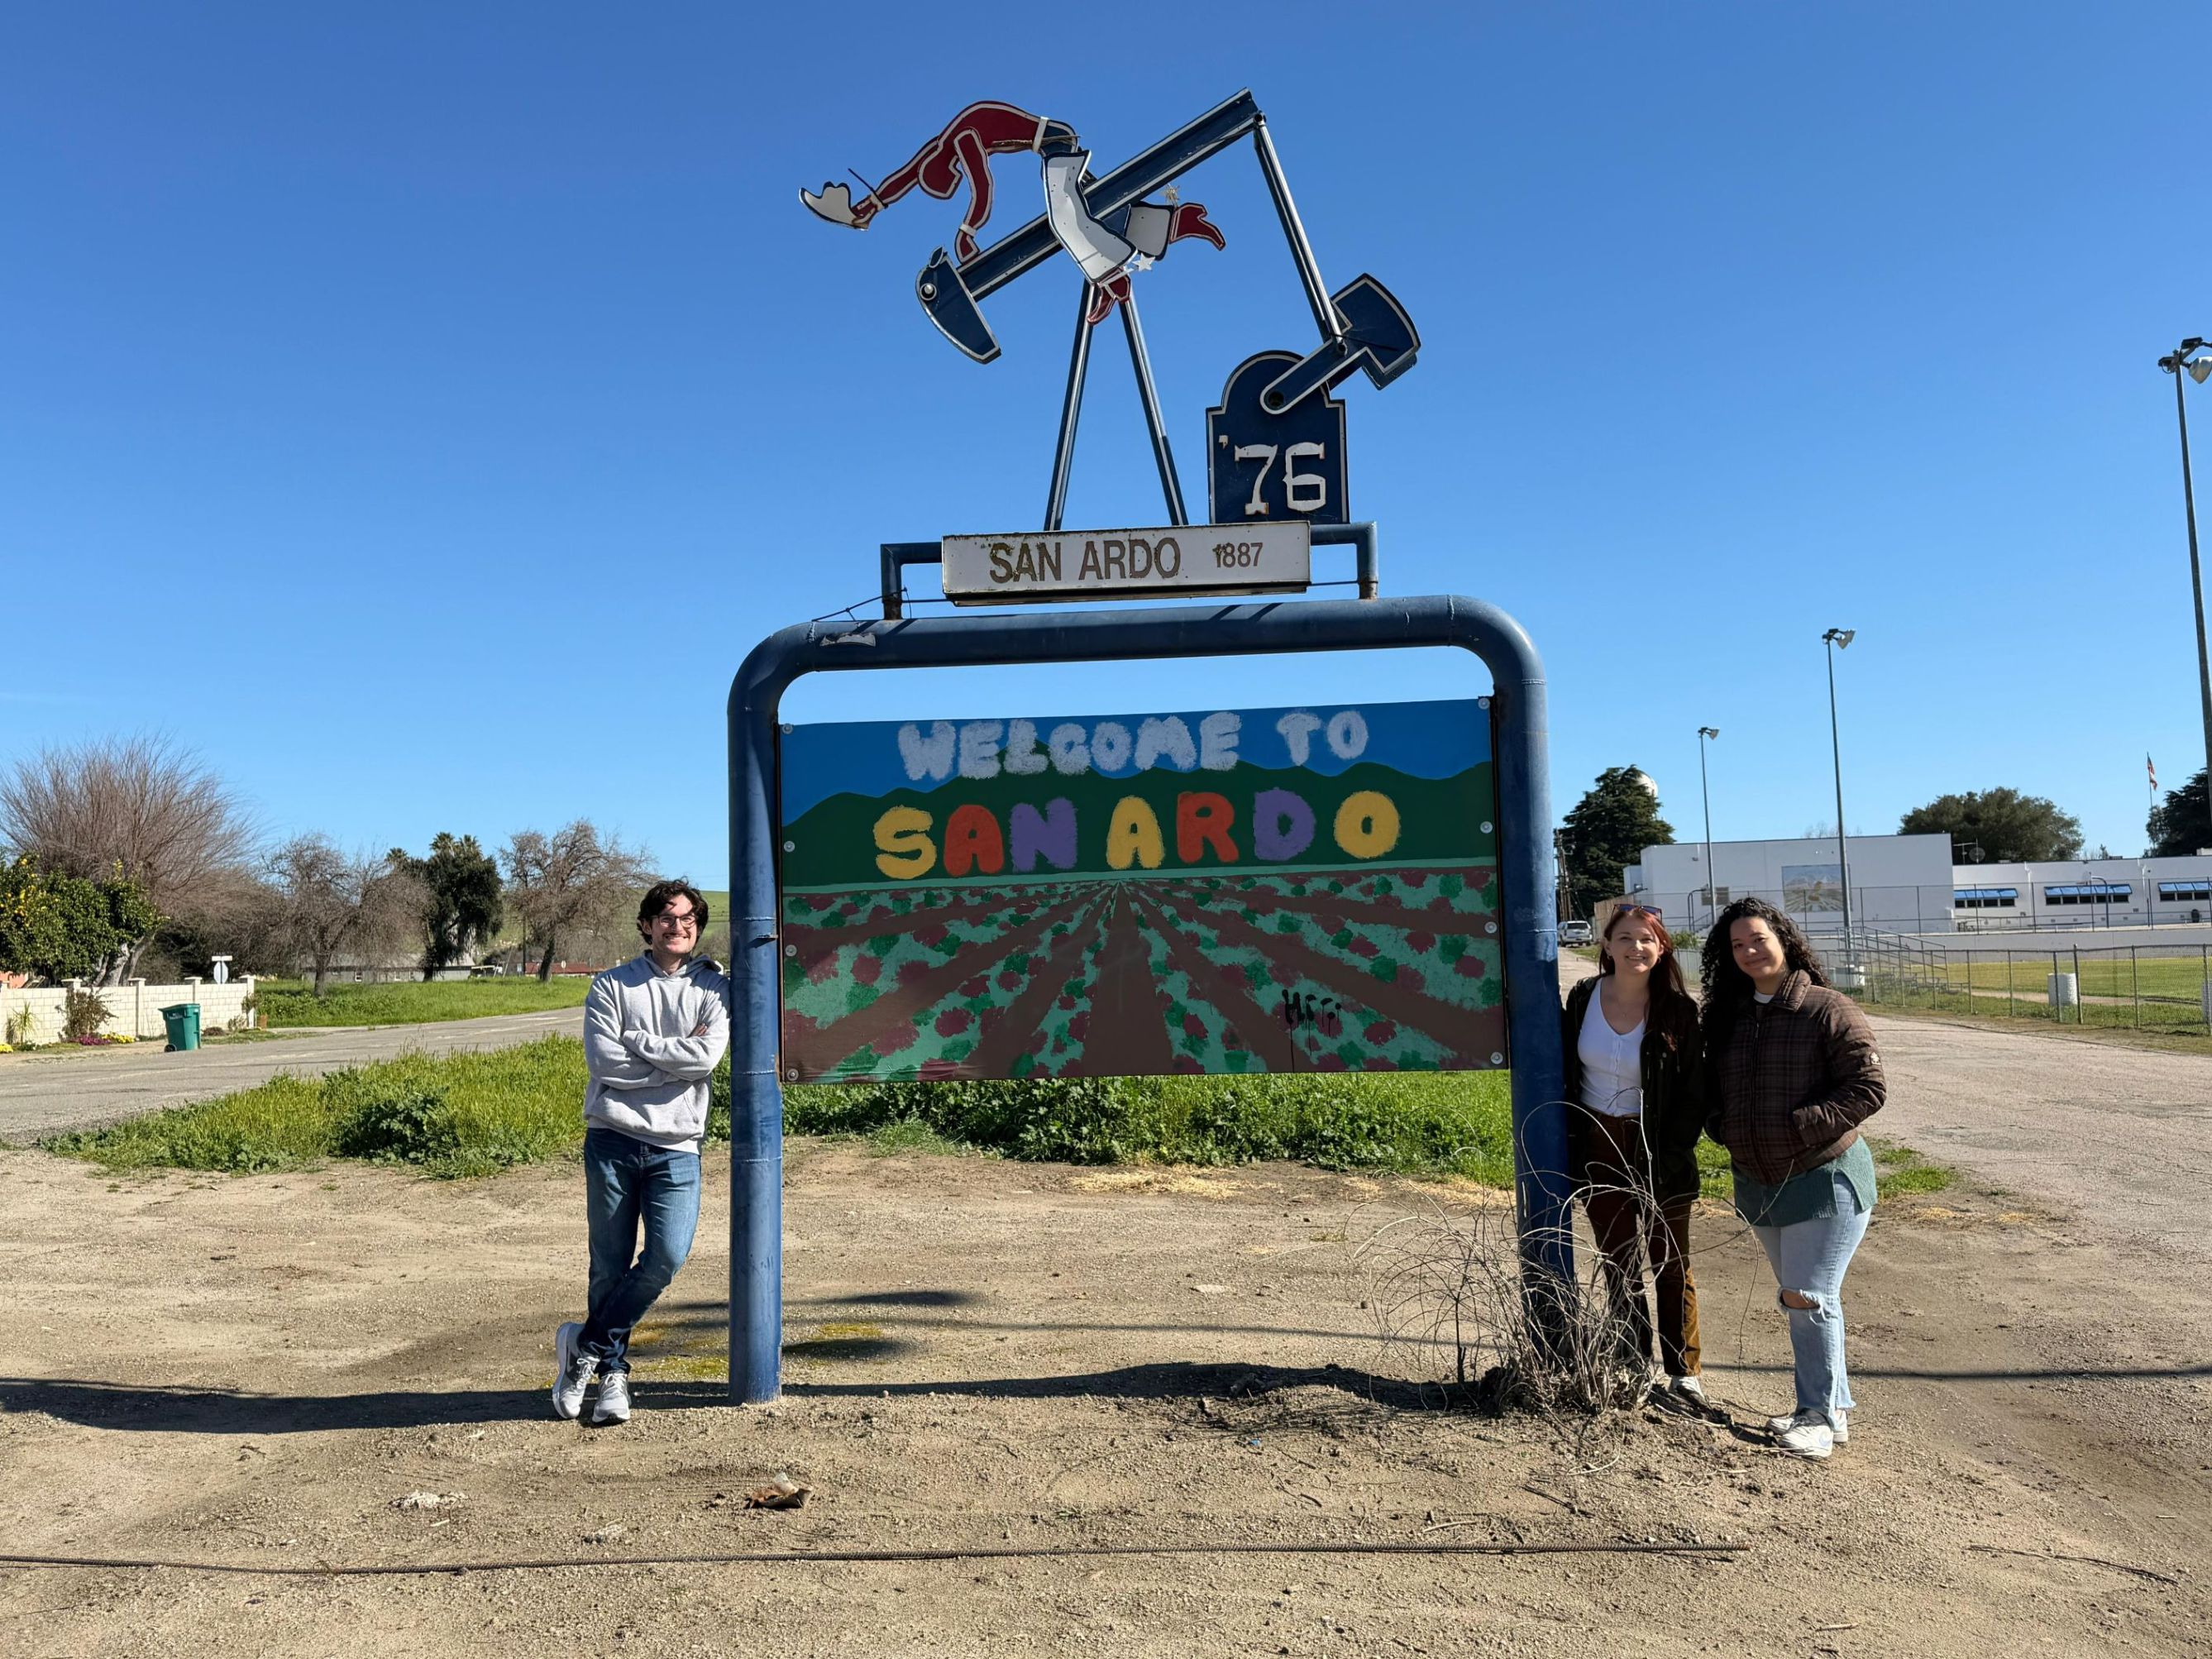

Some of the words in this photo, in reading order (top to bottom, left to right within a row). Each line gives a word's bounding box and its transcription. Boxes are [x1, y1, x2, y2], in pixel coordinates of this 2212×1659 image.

[989, 542, 1063, 584] SAN
[1078, 538, 1182, 582] ARDO
[1214, 542, 1264, 569] 1887
[897, 712, 1244, 781] WELCOME
[1277, 710, 1369, 767] TO
[873, 797, 1078, 880] SAN
[1106, 788, 1401, 870] ARDO
